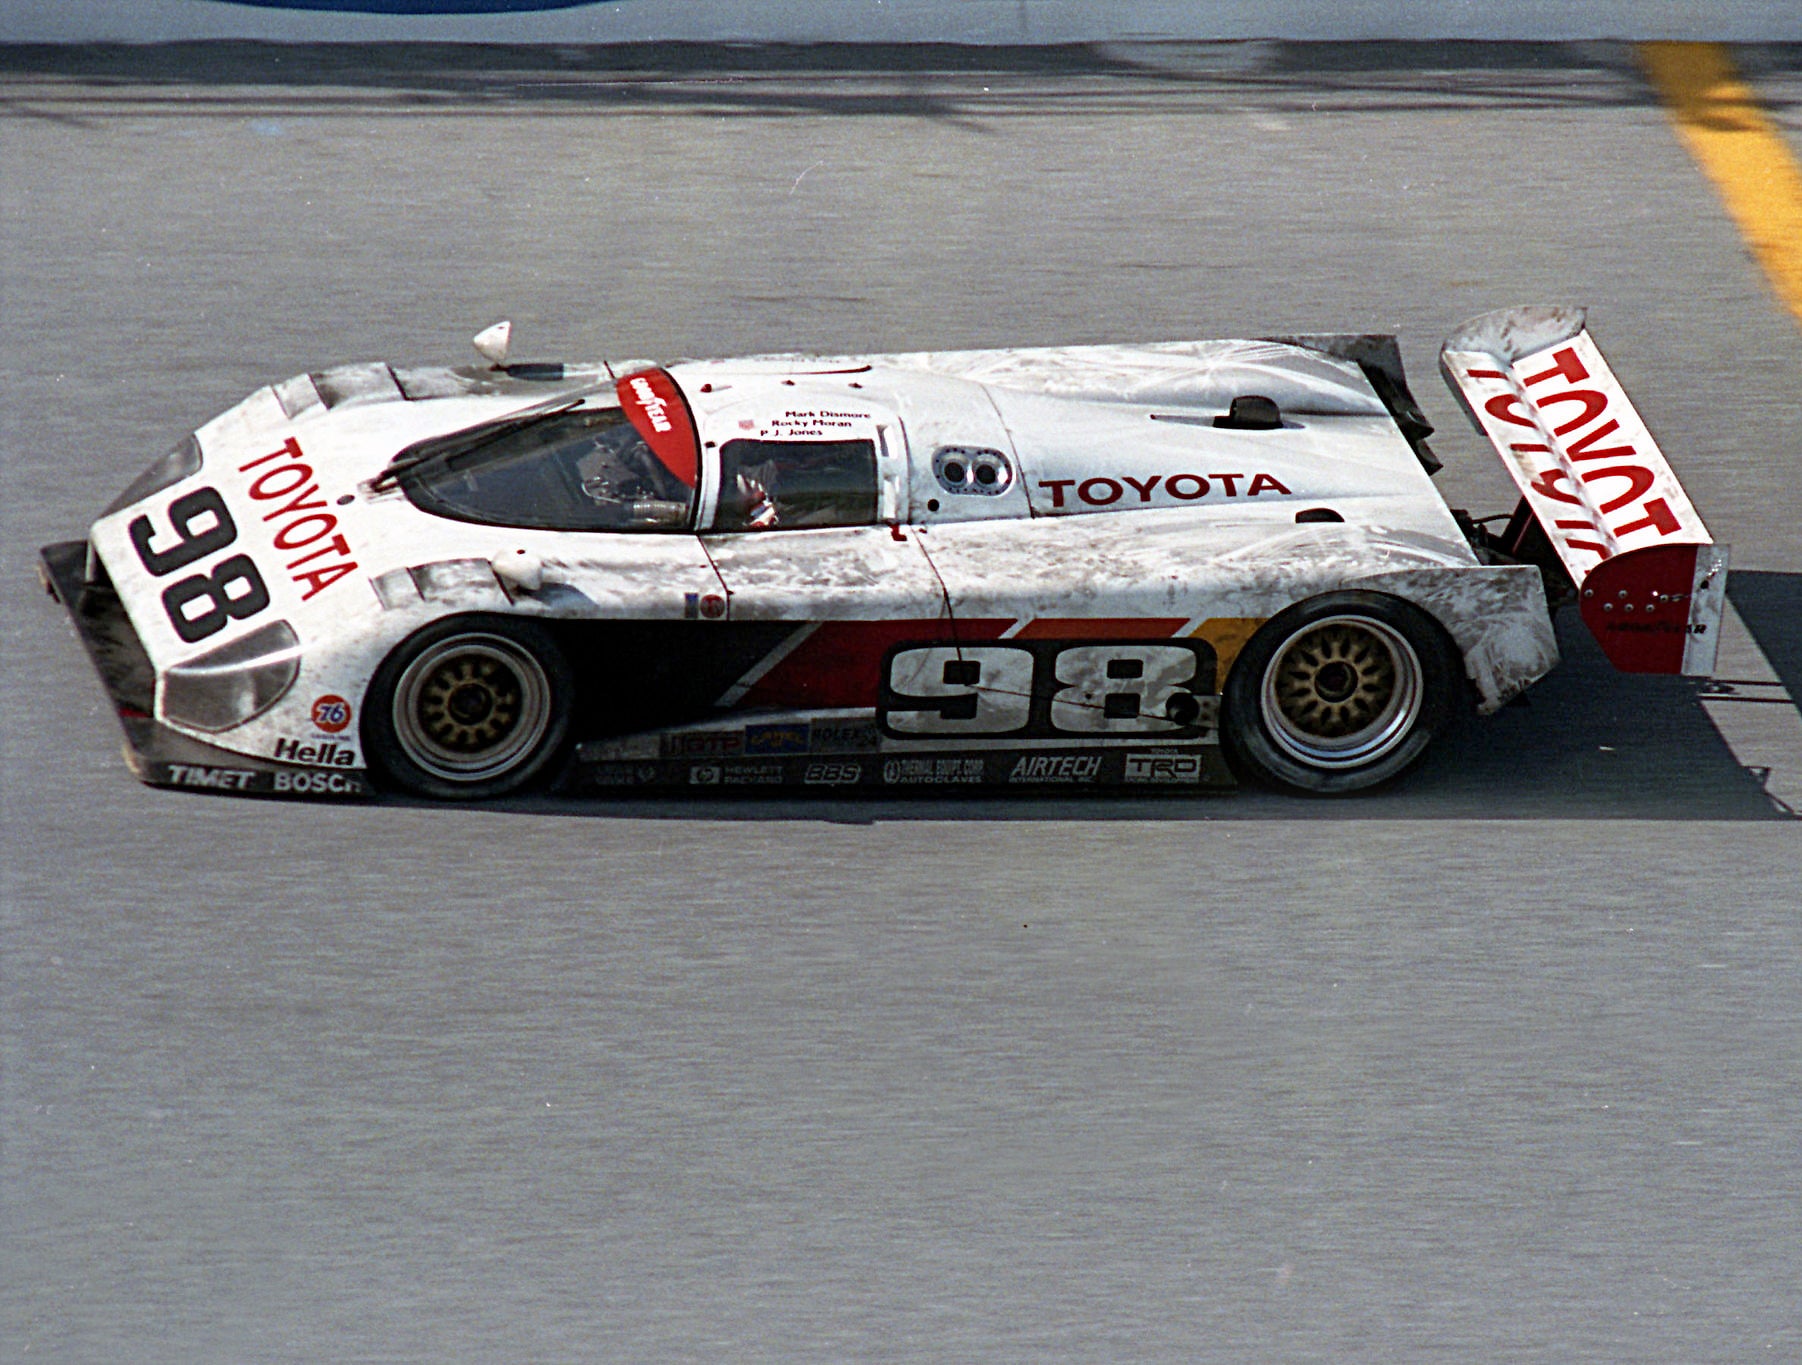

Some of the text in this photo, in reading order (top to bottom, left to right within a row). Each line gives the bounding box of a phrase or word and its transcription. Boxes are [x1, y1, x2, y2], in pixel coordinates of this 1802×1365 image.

[820, 411, 871, 419] Dismore
[1038, 473, 1292, 508] TOYOTA
[239, 437, 358, 601] TOYOTA
[128, 486, 271, 643] 98
[886, 645, 1197, 734] 98
[317, 702, 345, 723] 76
[273, 737, 356, 766] Hella
[168, 764, 256, 789] TIMET
[1011, 756, 1102, 776] AIRTECH
[1129, 758, 1198, 779] TRD
[901, 776, 982, 784] AUTOCLAVES
